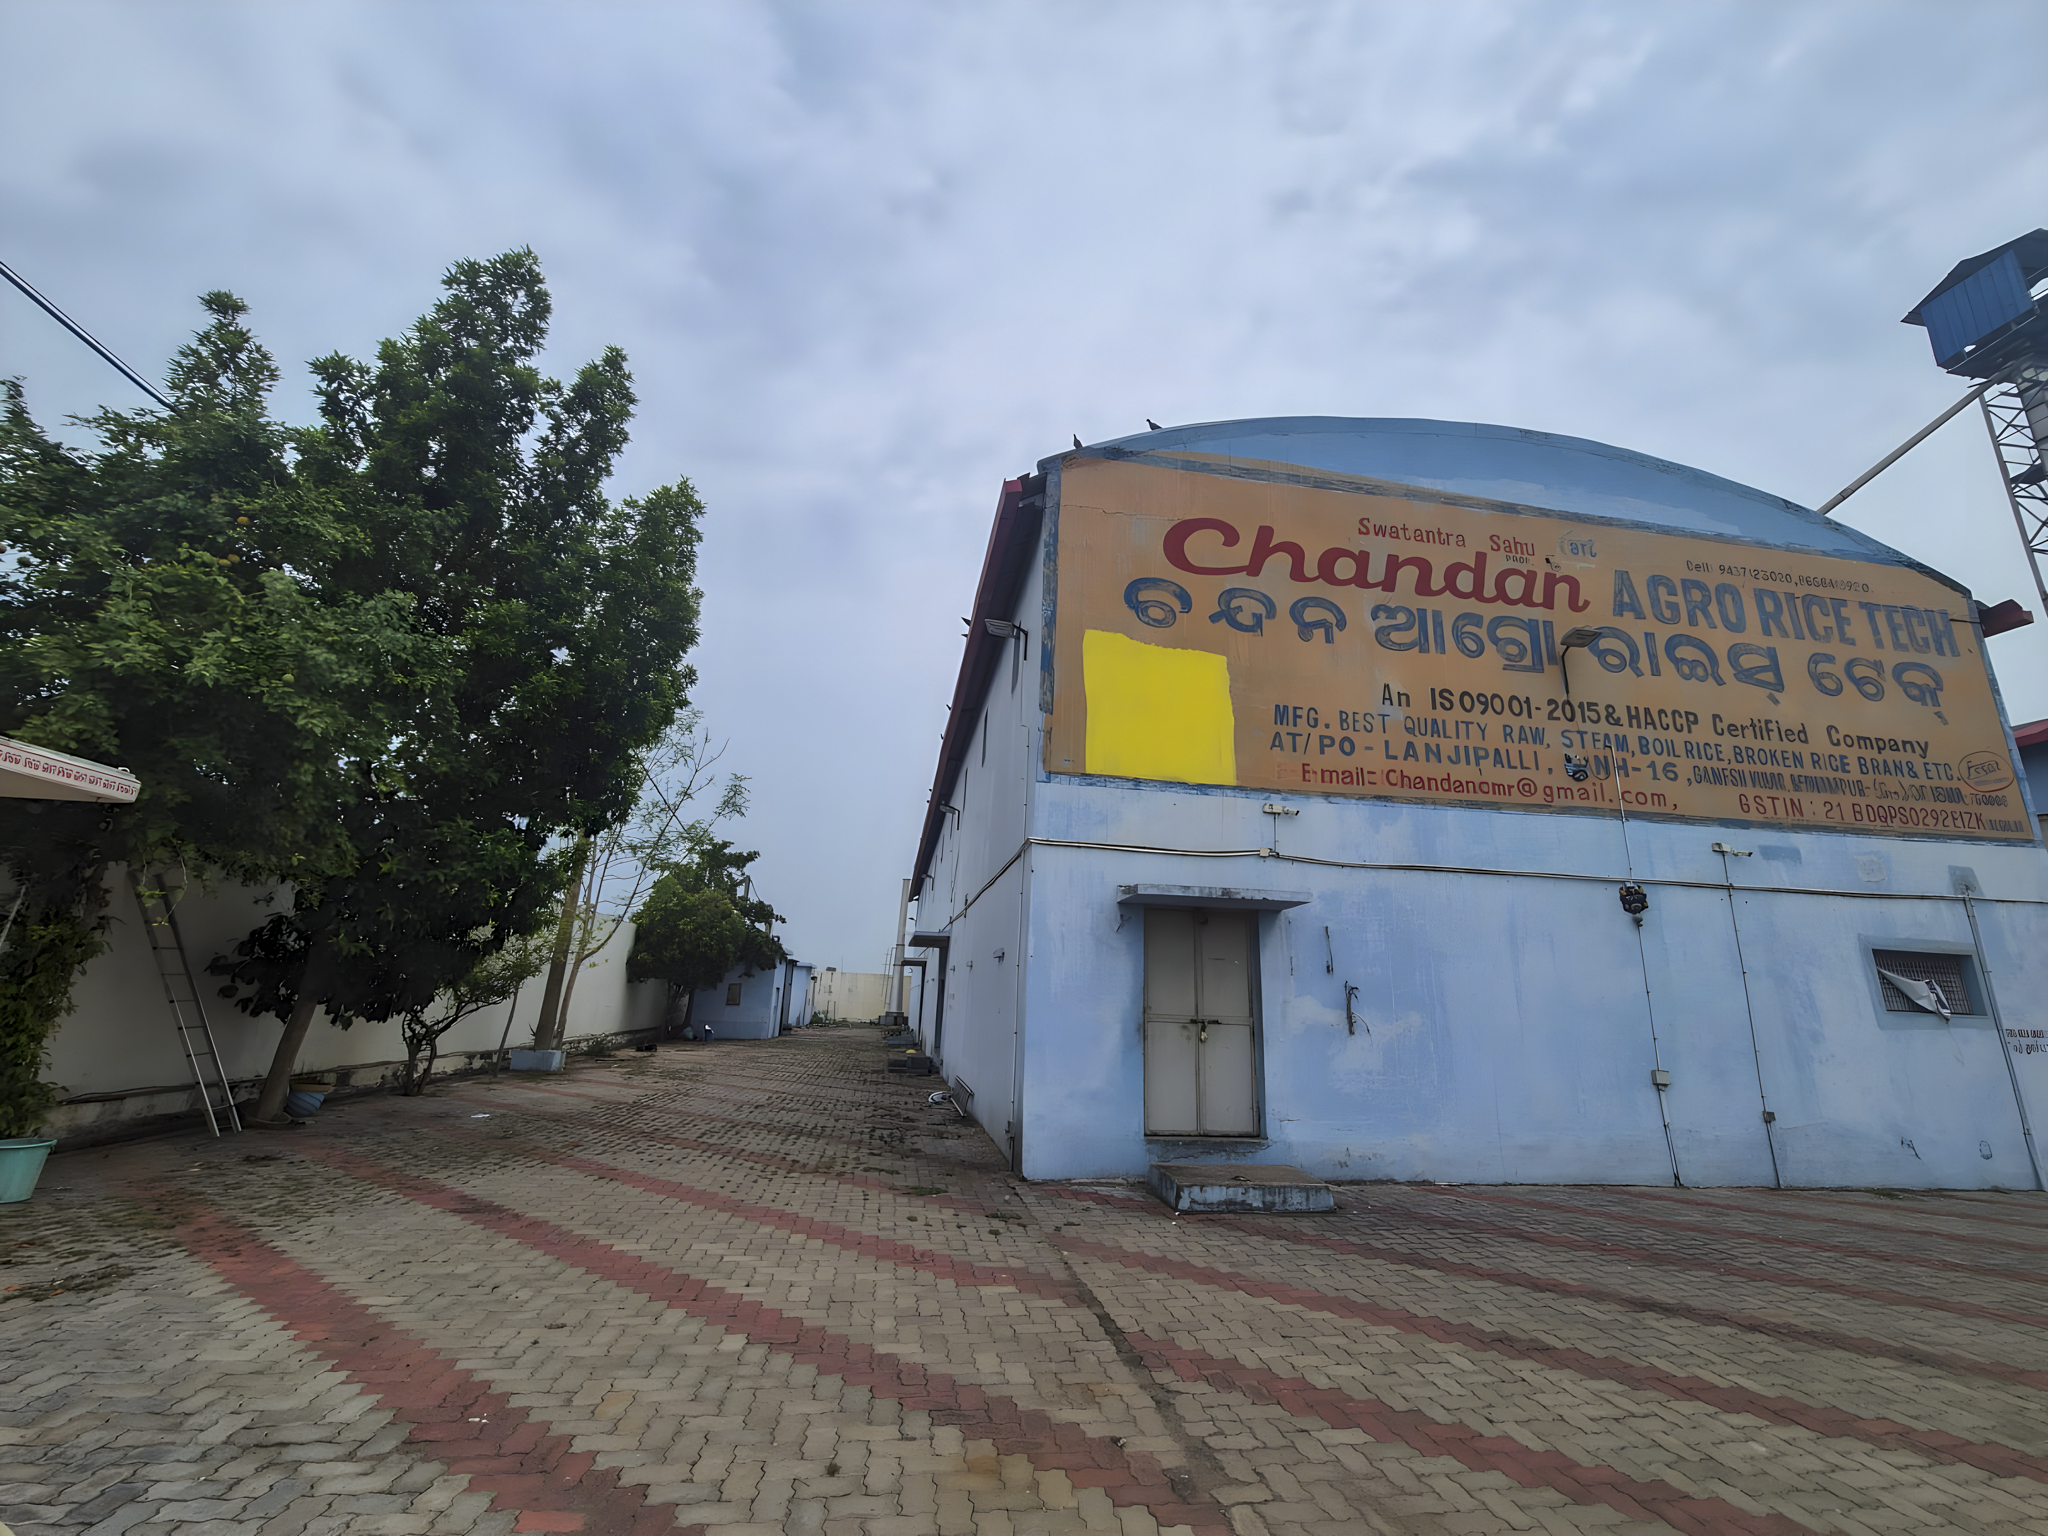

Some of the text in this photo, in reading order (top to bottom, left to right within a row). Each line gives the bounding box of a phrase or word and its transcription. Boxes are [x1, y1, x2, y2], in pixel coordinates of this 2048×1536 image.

[1358, 517, 1466, 548] Swatantra
[1489, 534, 1535, 557] Sahu
[1162, 517, 1590, 613] Chandan
[1612, 569, 1746, 633] AGRO
[1753, 588, 1857, 646] RICE
[1858, 601, 1961, 658] TECH
[1274, 703, 1331, 729] MFG.
[1339, 710, 1400, 734] BEST
[1404, 715, 1488, 742] QUALITY
[1732, 745, 1805, 770] BROKEN
[1810, 752, 1851, 774] RICE
[1382, 683, 1411, 708] An
[1826, 724, 1930, 760] Company
